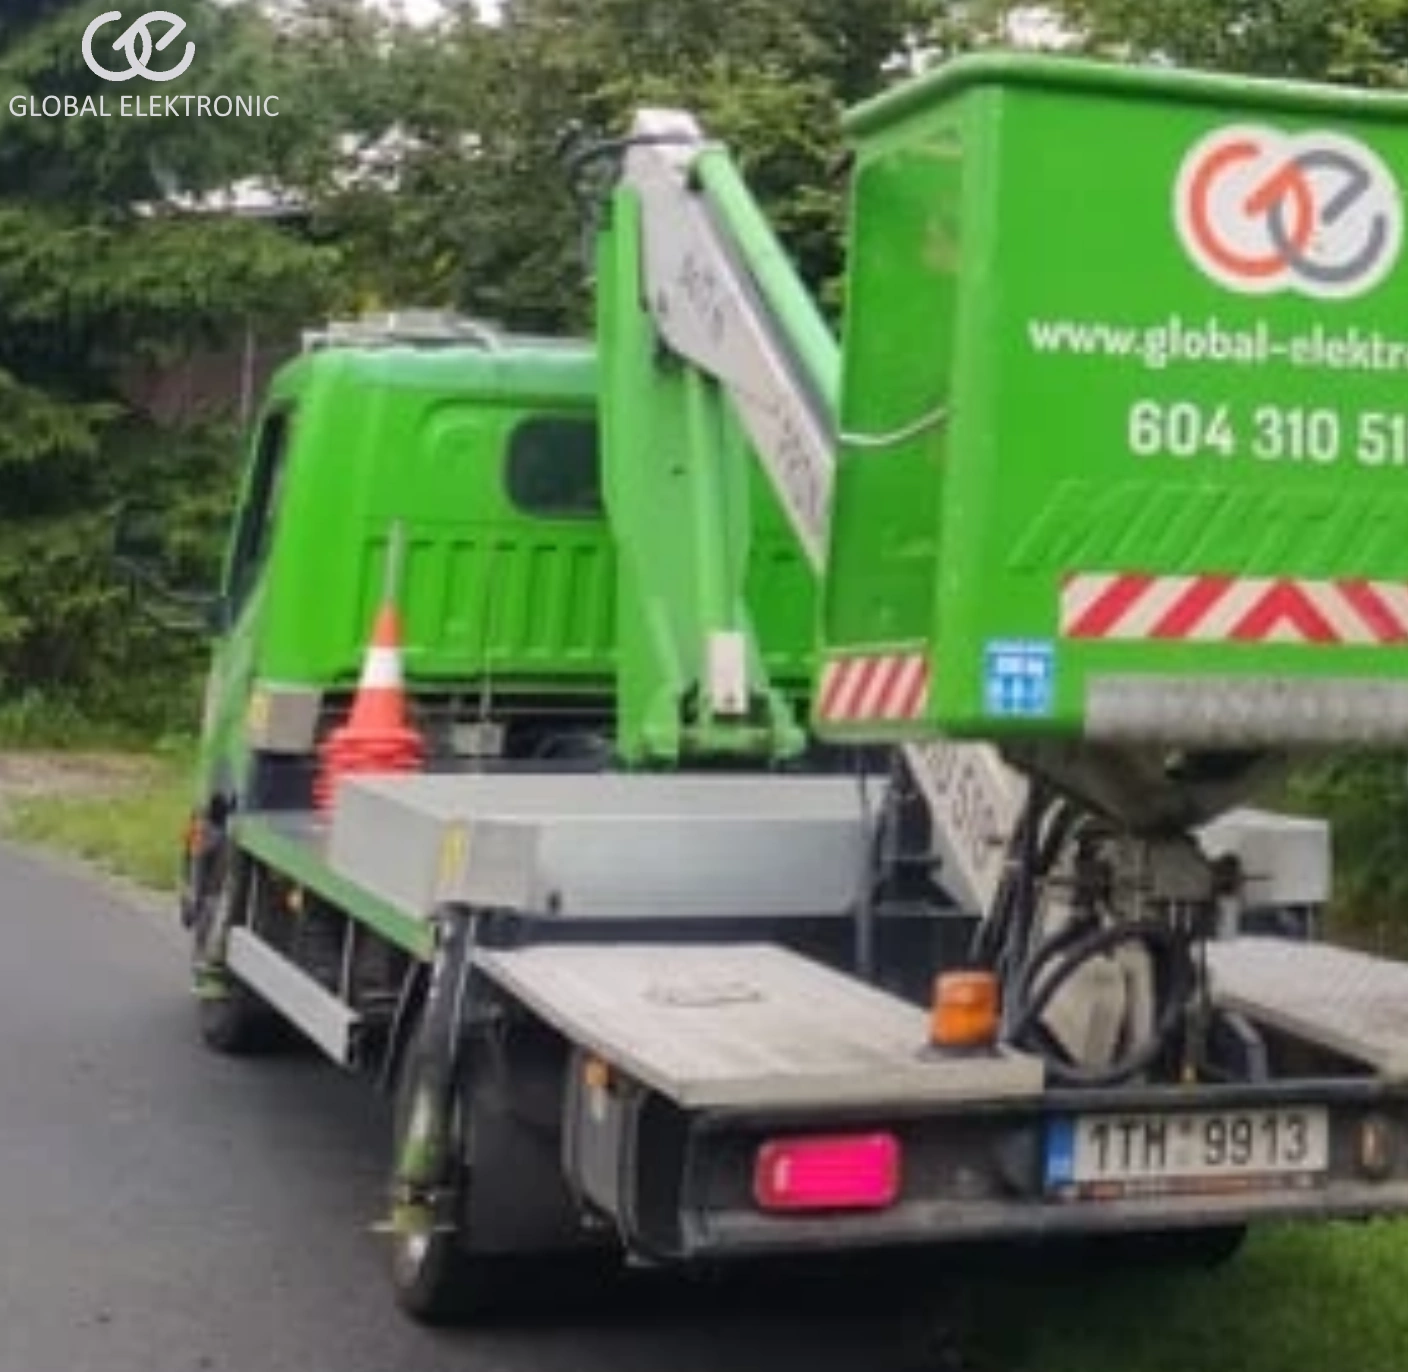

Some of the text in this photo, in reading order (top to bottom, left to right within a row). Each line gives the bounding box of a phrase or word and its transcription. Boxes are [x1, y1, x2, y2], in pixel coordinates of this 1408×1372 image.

[1128, 400, 1235, 456] 604
[1252, 407, 1340, 461] 310
[1203, 1112, 1309, 1166] 9913
